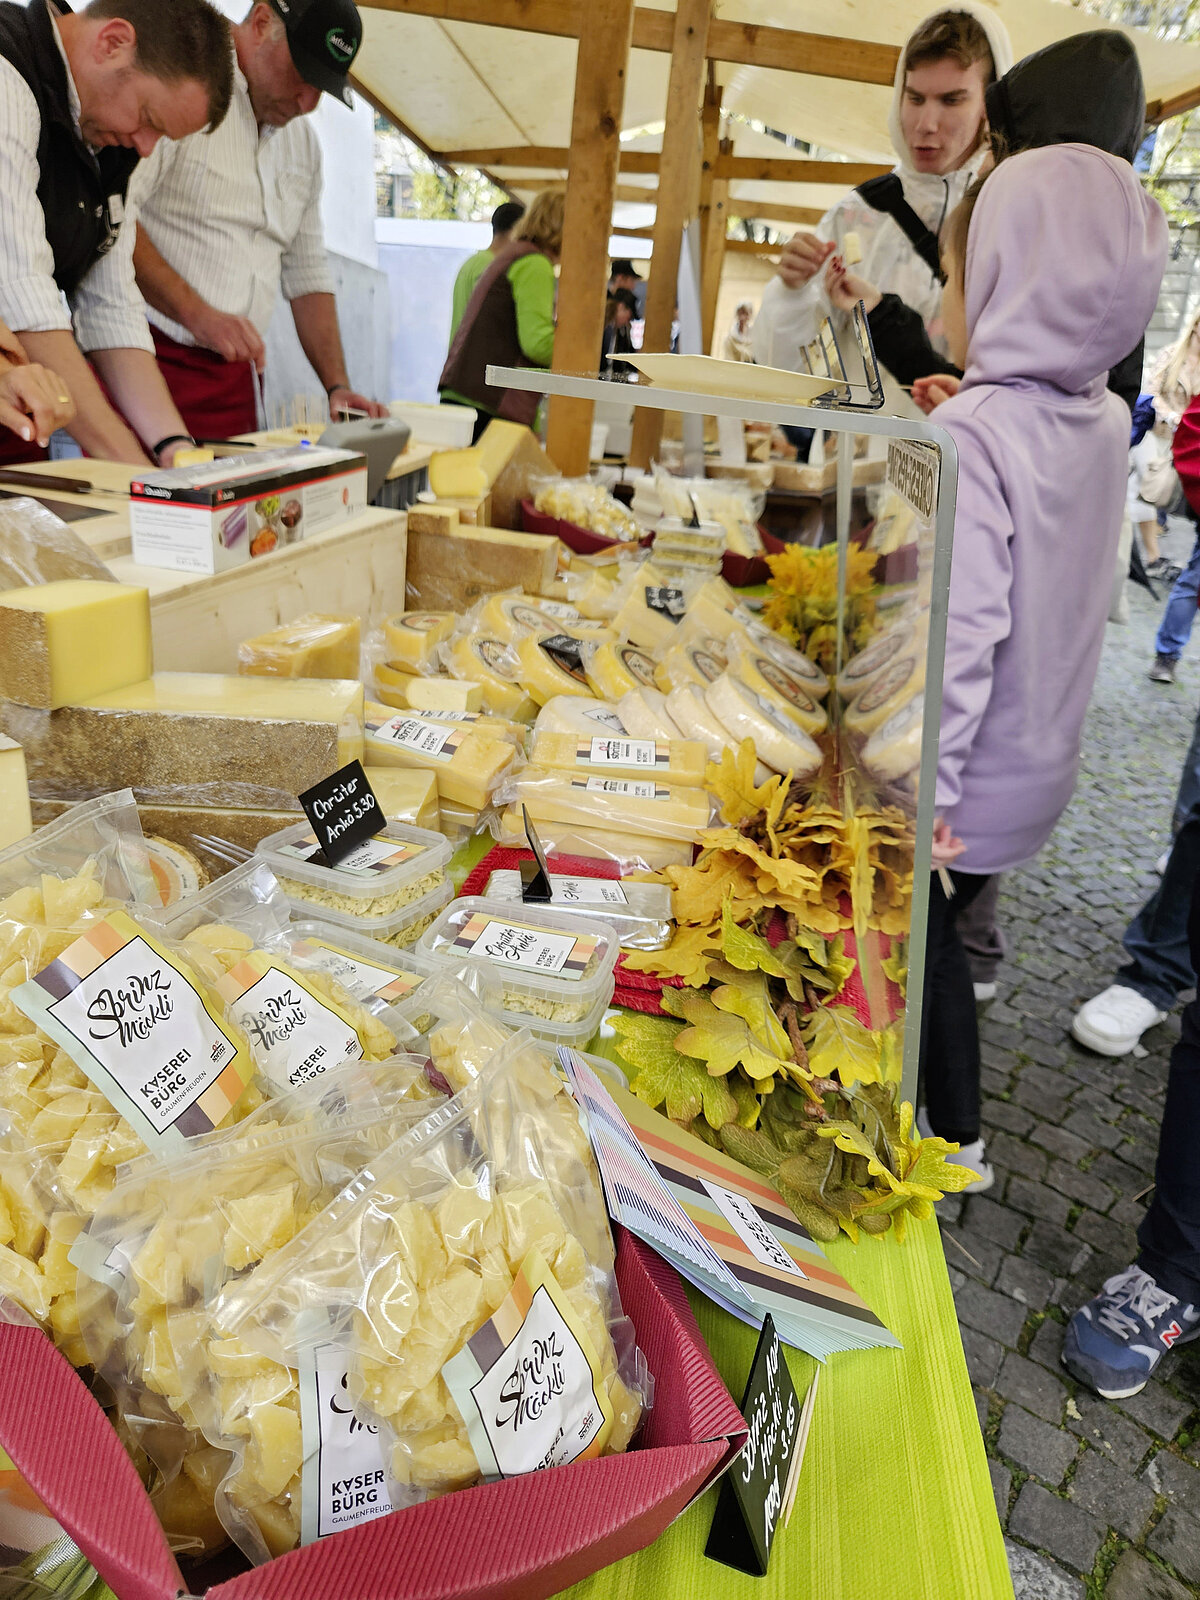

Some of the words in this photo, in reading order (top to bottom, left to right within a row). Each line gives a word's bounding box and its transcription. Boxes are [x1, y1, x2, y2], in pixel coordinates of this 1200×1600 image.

[313, 778, 358, 820] Chrüter
[352, 793, 375, 819] 5.30
[87, 969, 172, 1040] Sbrinz
[119, 994, 174, 1048] Möckli
[150, 1073, 187, 1110] BÜRG
[160, 1070, 207, 1117] GAUMENFREUDEN
[495, 1331, 565, 1428] Sbrinz
[331, 1503, 394, 1524] GAUMENFREUD
[332, 1488, 378, 1514] BÜRG
